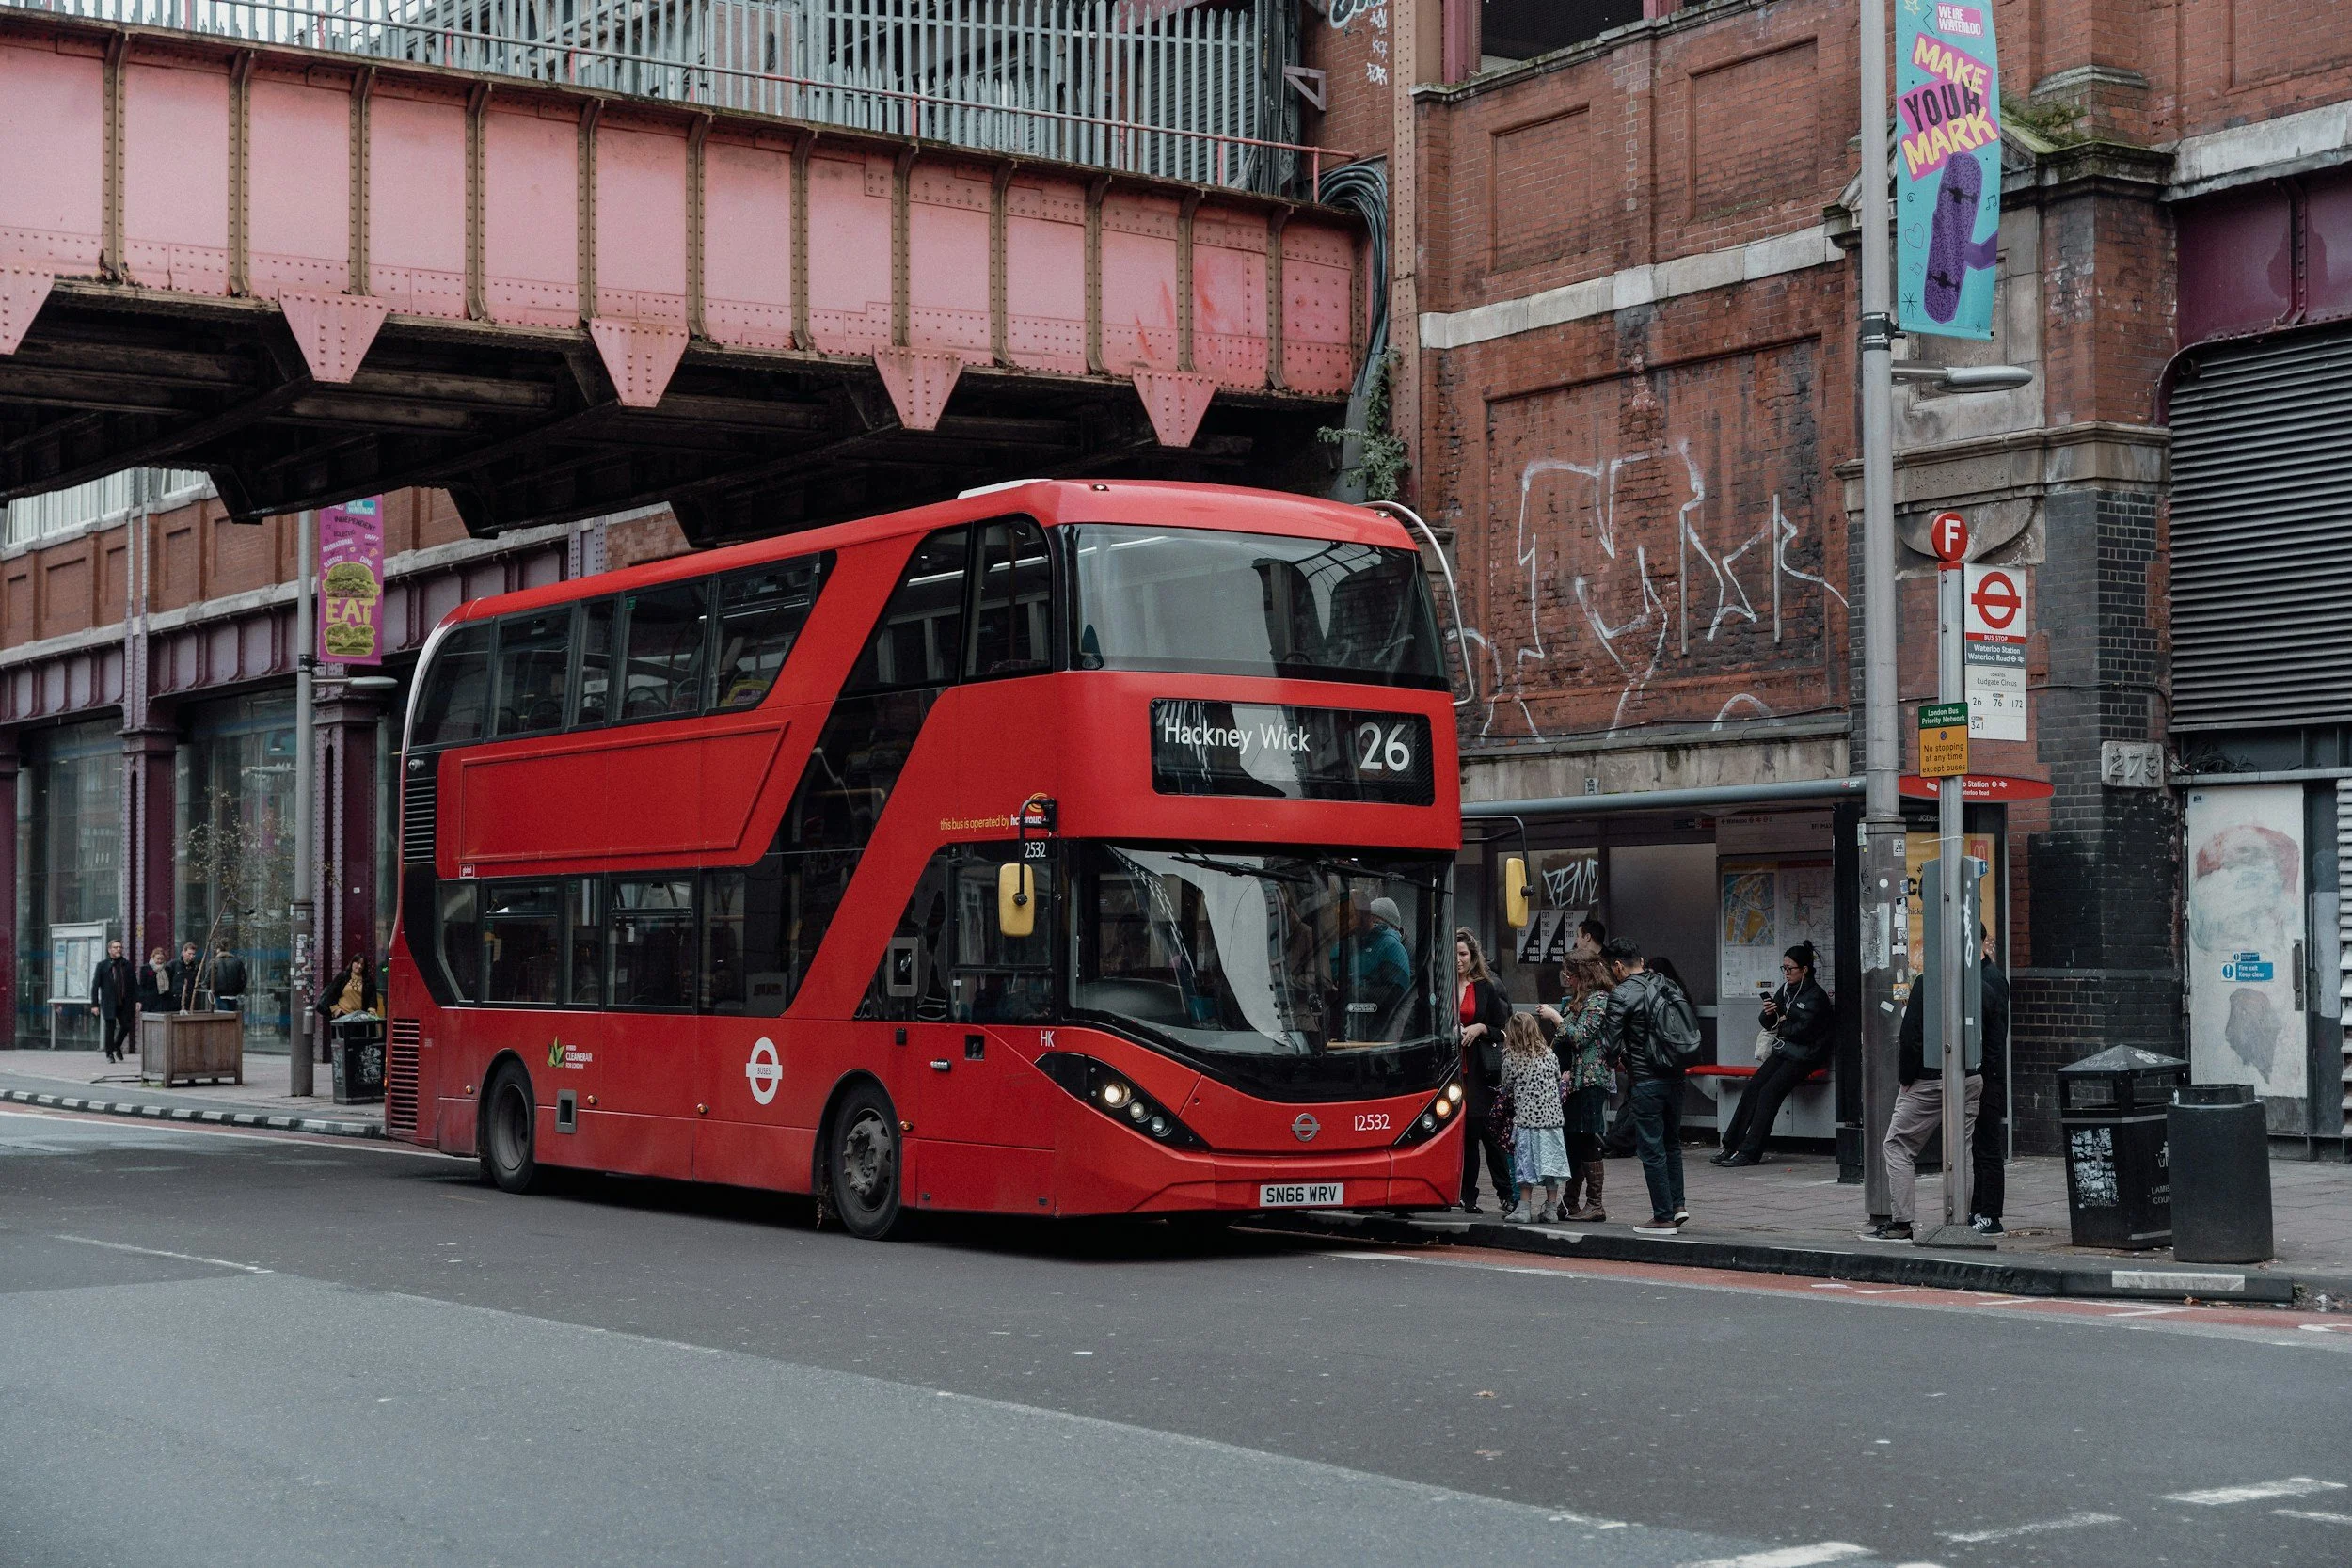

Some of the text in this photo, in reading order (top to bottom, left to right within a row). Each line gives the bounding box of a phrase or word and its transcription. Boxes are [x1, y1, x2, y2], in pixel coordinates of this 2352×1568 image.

[1938, 17, 1981, 36] WATERLOO
[1914, 36, 1987, 94] MAKE
[1903, 79, 1981, 132] YOUR
[1902, 106, 1998, 175] MARK
[334, 515, 376, 532] INDEPENDENT
[1944, 519, 1961, 553] F
[325, 598, 376, 625] EAT
[1973, 643, 2021, 655] Waterloo Station
[1967, 652, 2010, 662] Waterloo Road
[1977, 677, 2017, 687] Ludgate Circus
[1972, 697, 2023, 708] 26 76 172
[1921, 717, 1942, 725] Priority
[1942, 714, 1966, 723] Network
[1970, 721, 1984, 730] 341
[1164, 717, 1410, 771] Hackney Wick 26
[1924, 742, 1964, 752] No stopping
[1933, 754, 1946, 763] any
[1922, 763, 1965, 773] except buses
[1967, 779, 1990, 788] Station
[940, 814, 1042, 832] this bus is operated by hc roup
[1024, 841, 1047, 859] 2532
[1908, 907, 1923, 916] hick
[1040, 1030, 1055, 1047] HK
[757, 1067, 771, 1075] BUSES
[1354, 1113, 1391, 1132] 12532
[1266, 1185, 1337, 1203] SN66 WRV
[2151, 1184, 2170, 1195] LAMB
